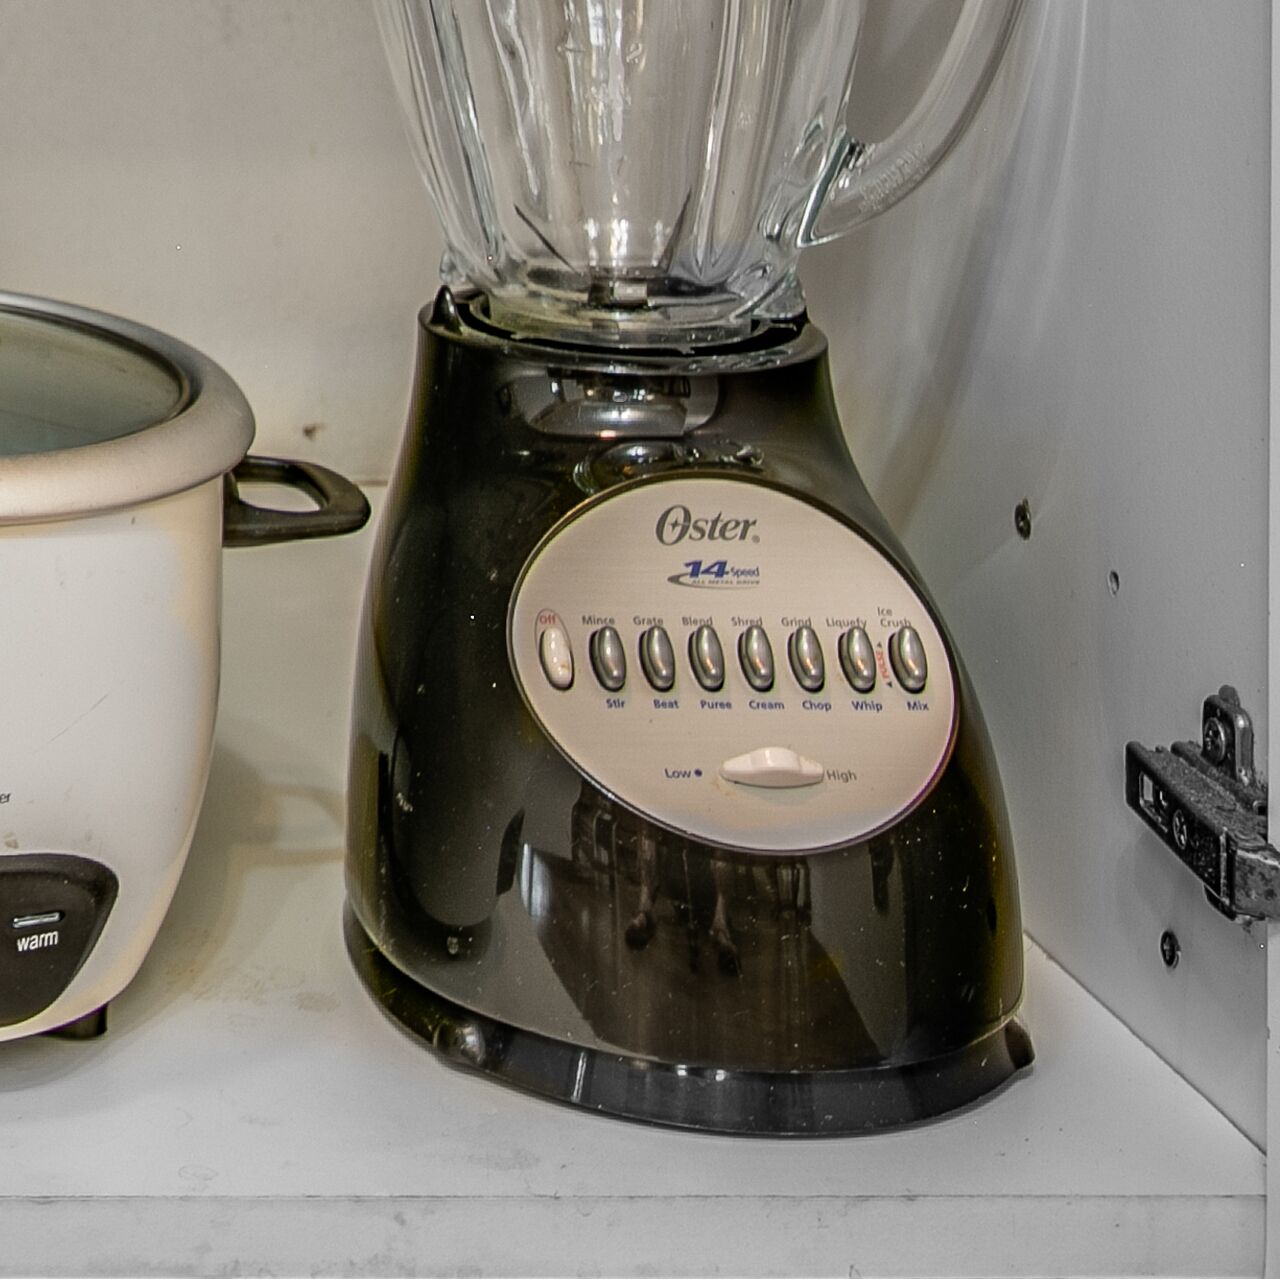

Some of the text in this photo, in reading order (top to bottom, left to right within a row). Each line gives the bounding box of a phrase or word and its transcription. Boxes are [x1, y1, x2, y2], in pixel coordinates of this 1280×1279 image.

[656, 504, 757, 546] Oster
[684, 560, 759, 578] 14 Speed
[877, 606, 892, 617] Ice
[540, 614, 556, 625] Off
[582, 616, 615, 626] Mince
[633, 616, 664, 626] Grate
[682, 616, 713, 626] Blend
[731, 616, 763, 627] Shred
[781, 617, 811, 627] Grind
[826, 618, 867, 628] Liquefy
[880, 618, 912, 628] Crush
[606, 699, 626, 709] Stir
[653, 699, 679, 709] Beat
[700, 700, 732, 710] Puree
[748, 700, 785, 710] Cream
[802, 700, 832, 712] Chop
[851, 700, 883, 713] Whip
[907, 701, 929, 711] Mix
[665, 768, 692, 779] Low
[826, 770, 857, 783] High
[16, 930, 59, 953] warm
